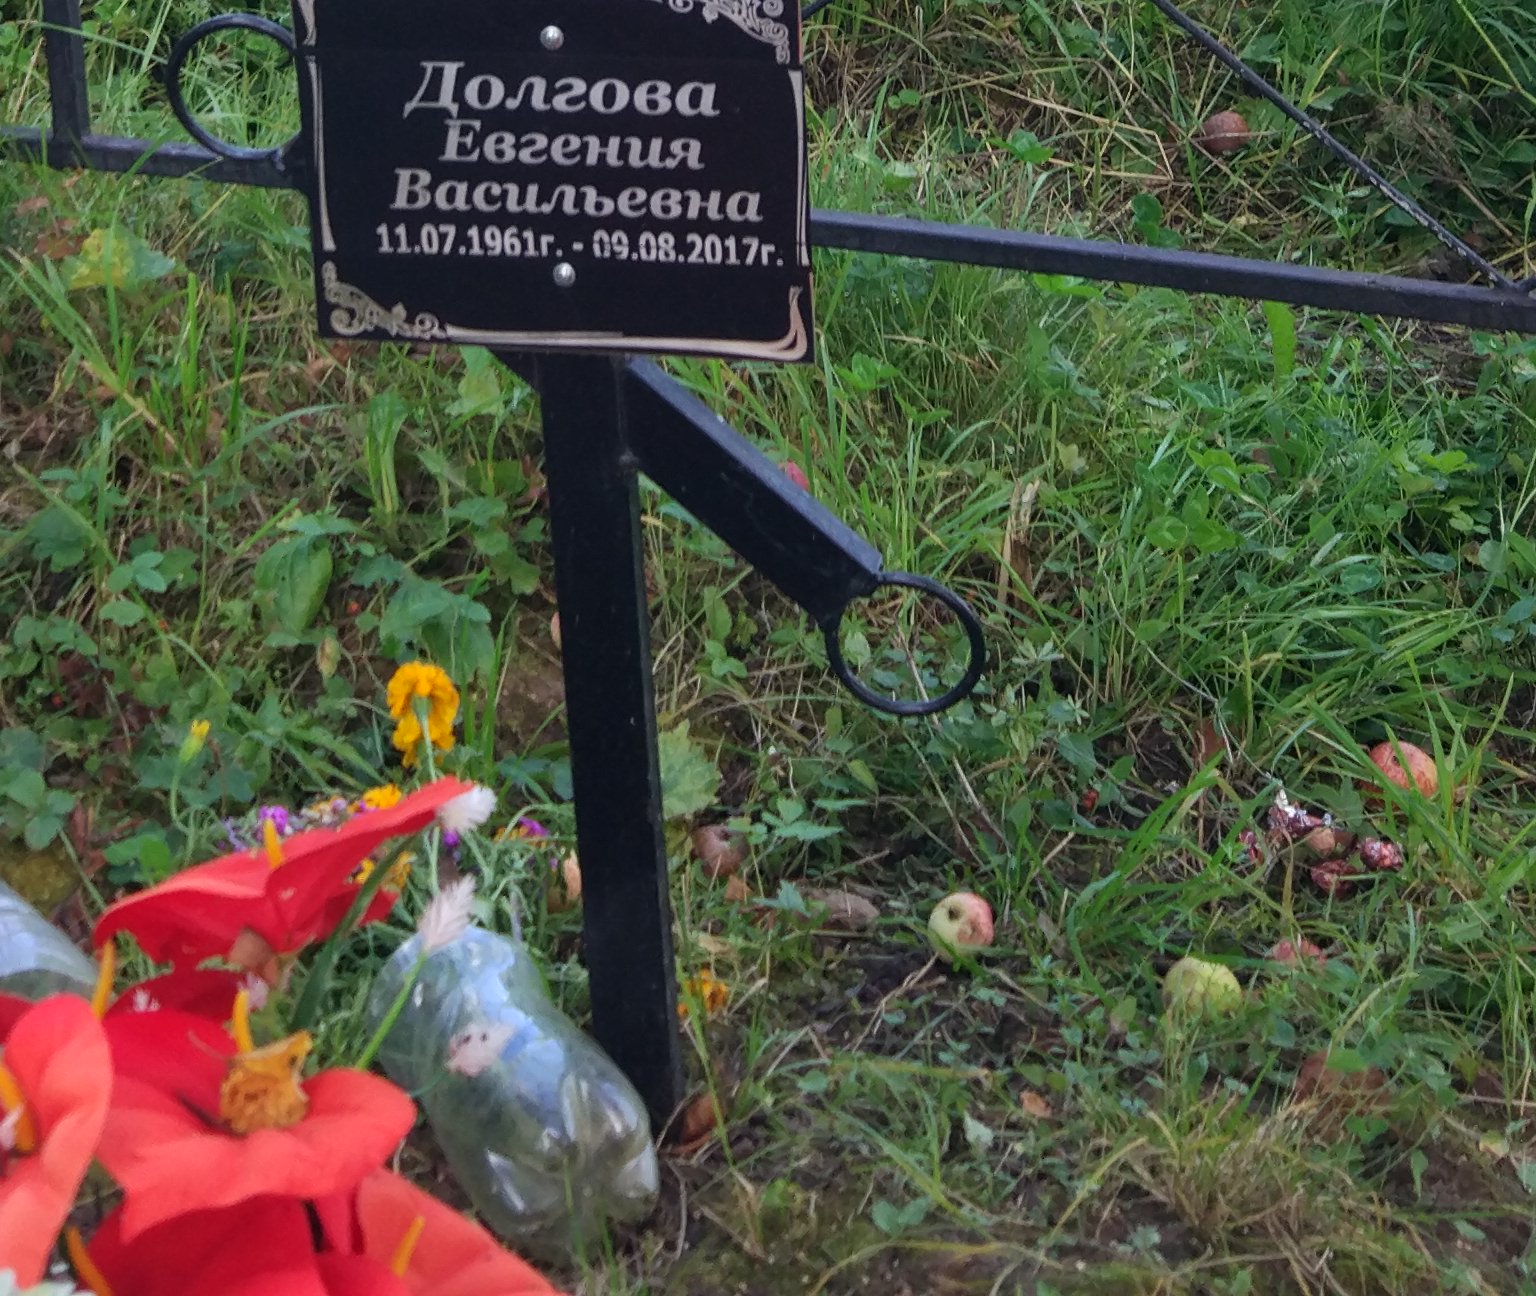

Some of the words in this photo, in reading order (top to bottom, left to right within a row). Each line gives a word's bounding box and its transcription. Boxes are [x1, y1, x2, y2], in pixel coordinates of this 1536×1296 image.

[404, 61, 720, 118] Долгова
[438, 119, 706, 171] Евгения
[389, 168, 764, 223] Васильевна
[592, 229, 784, 267] 09.08.2017г.
